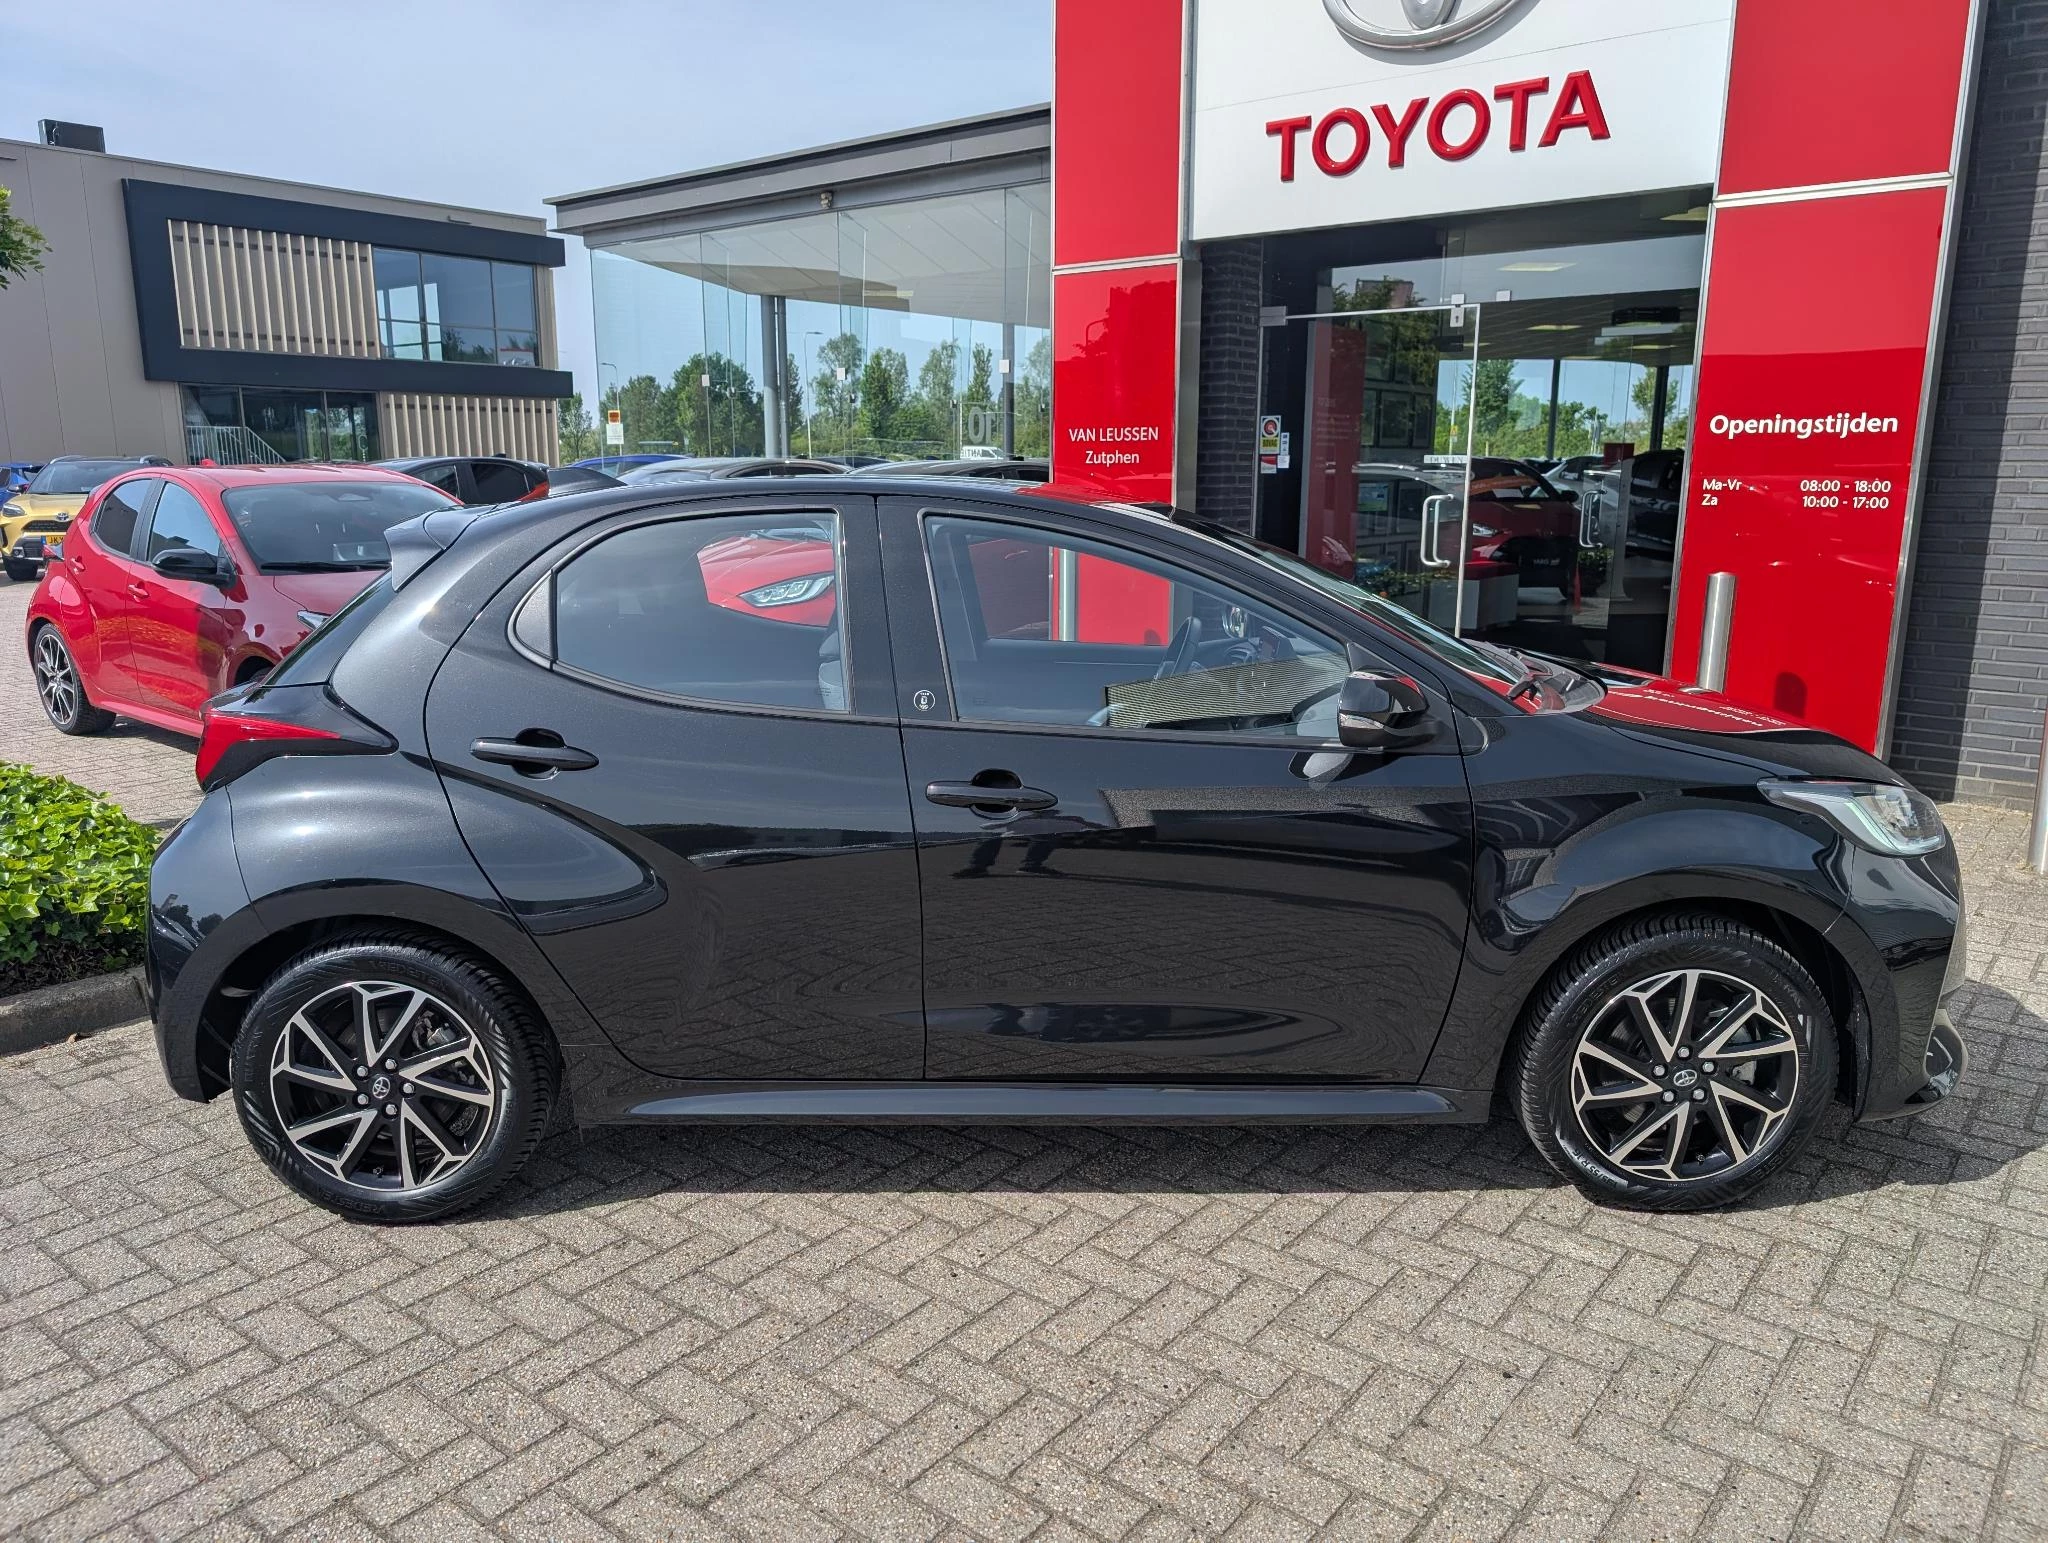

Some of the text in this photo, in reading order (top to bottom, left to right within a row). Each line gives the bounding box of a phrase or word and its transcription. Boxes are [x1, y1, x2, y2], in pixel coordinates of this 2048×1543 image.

[1266, 69, 1611, 182] TOYOTA
[1710, 412, 1898, 439] Openingstijden
[1069, 427, 1159, 442] VAN LEUSSEN
[1086, 451, 1139, 466] Zutphen
[1703, 479, 1742, 491] Ma-Vr
[1800, 480, 1840, 492] 08:00
[1855, 480, 1891, 493] 18:00
[1701, 494, 1718, 506] Za
[1803, 496, 1838, 508] 10:00
[1853, 497, 1888, 509] 17:00
